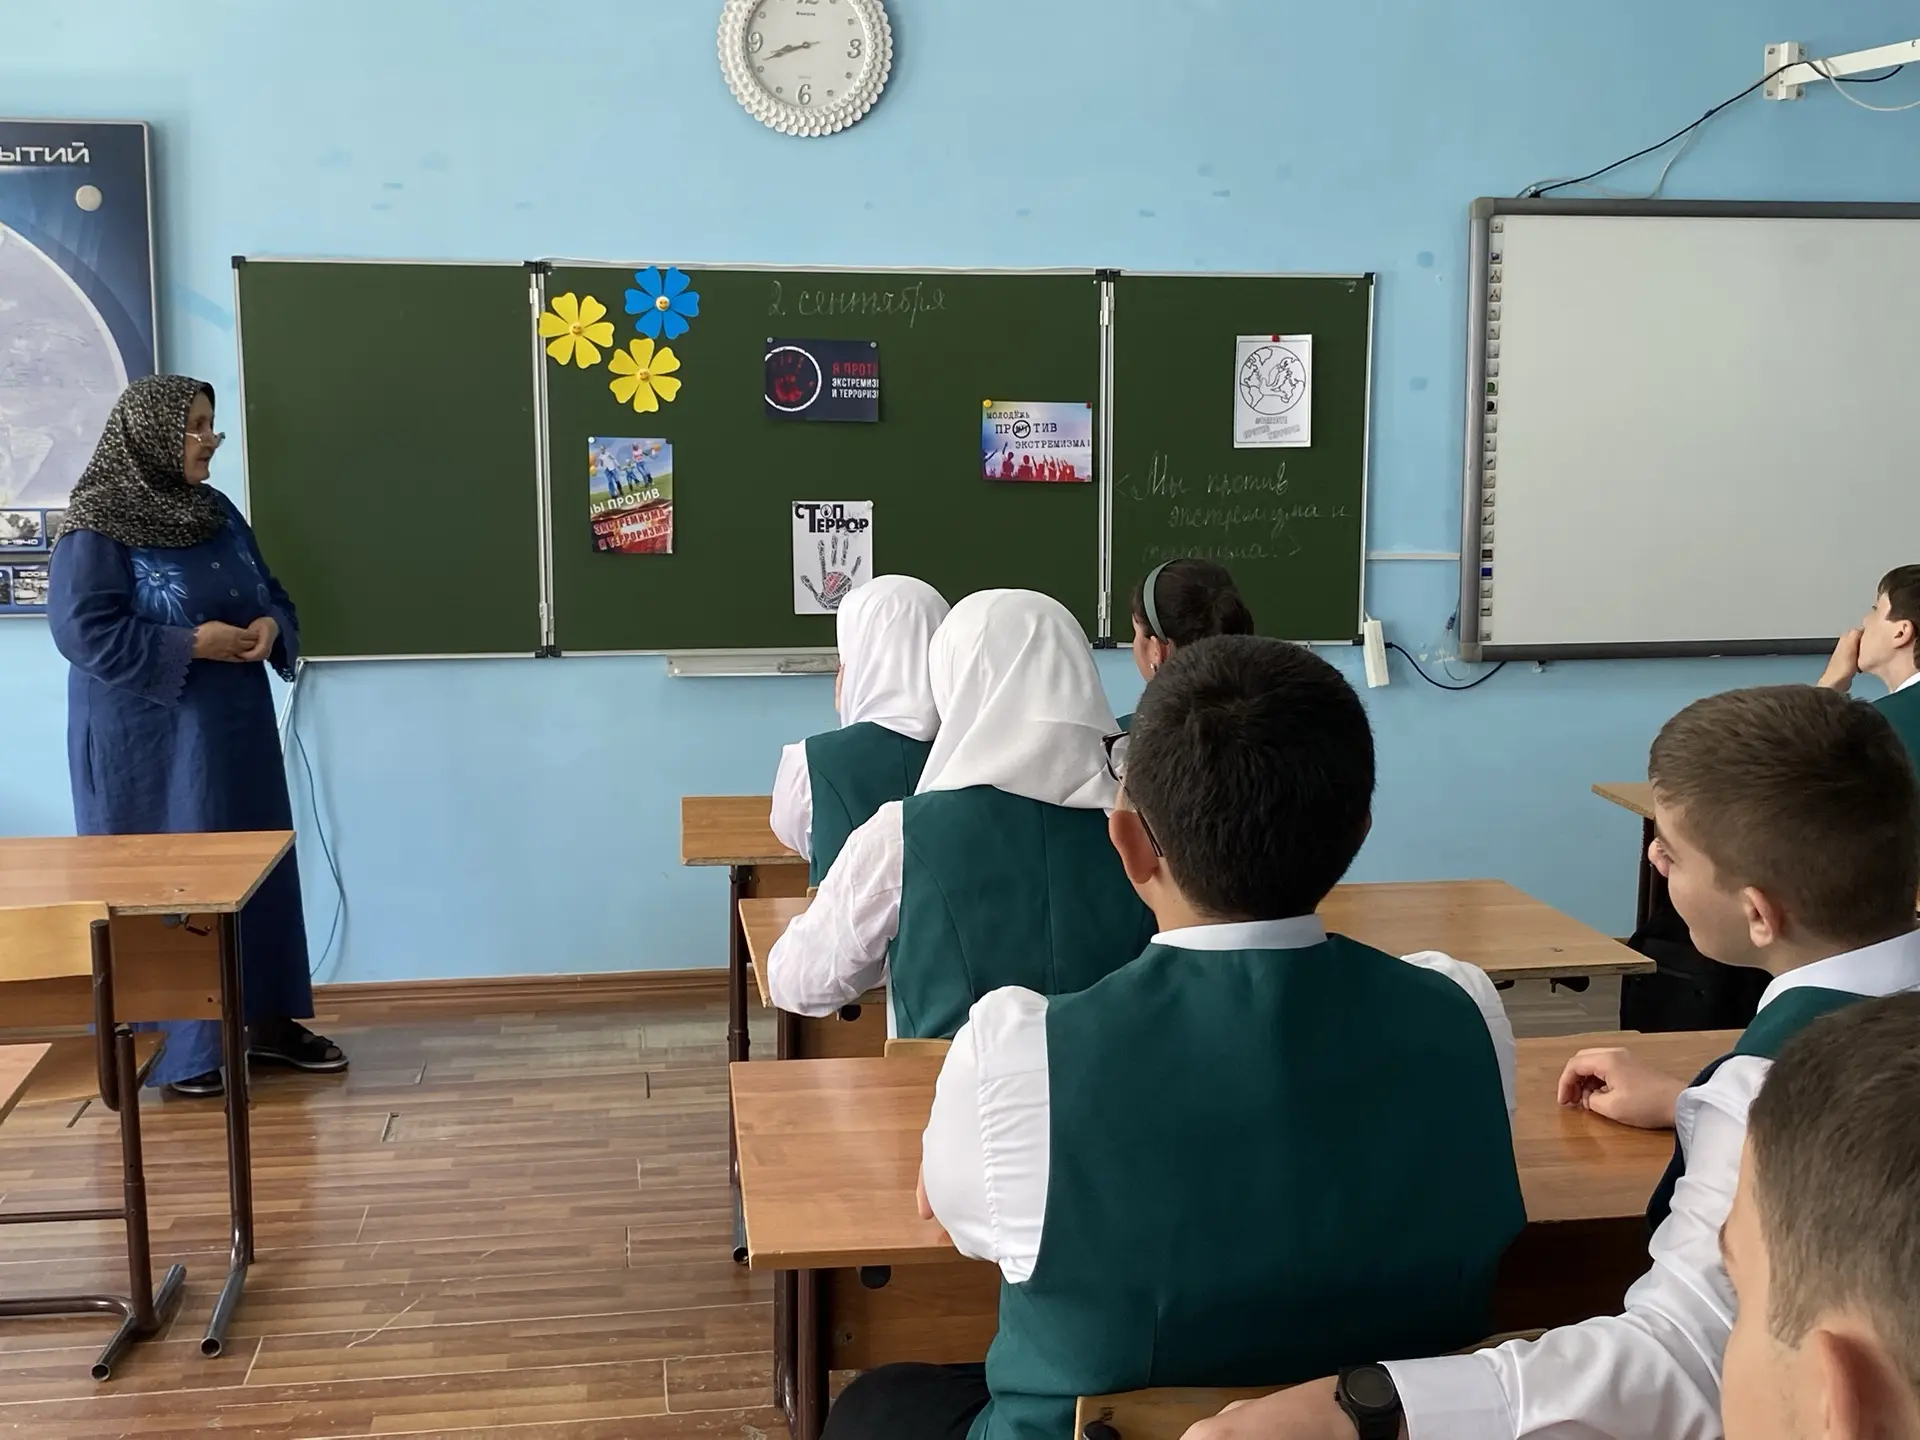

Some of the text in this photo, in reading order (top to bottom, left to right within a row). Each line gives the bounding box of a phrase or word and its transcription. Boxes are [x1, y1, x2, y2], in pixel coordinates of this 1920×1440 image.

[749, 32, 764, 53] 9
[847, 38, 861, 59] 3
[797, 83, 811, 105] 6
[607, 488, 660, 510] ПРОТИВ
